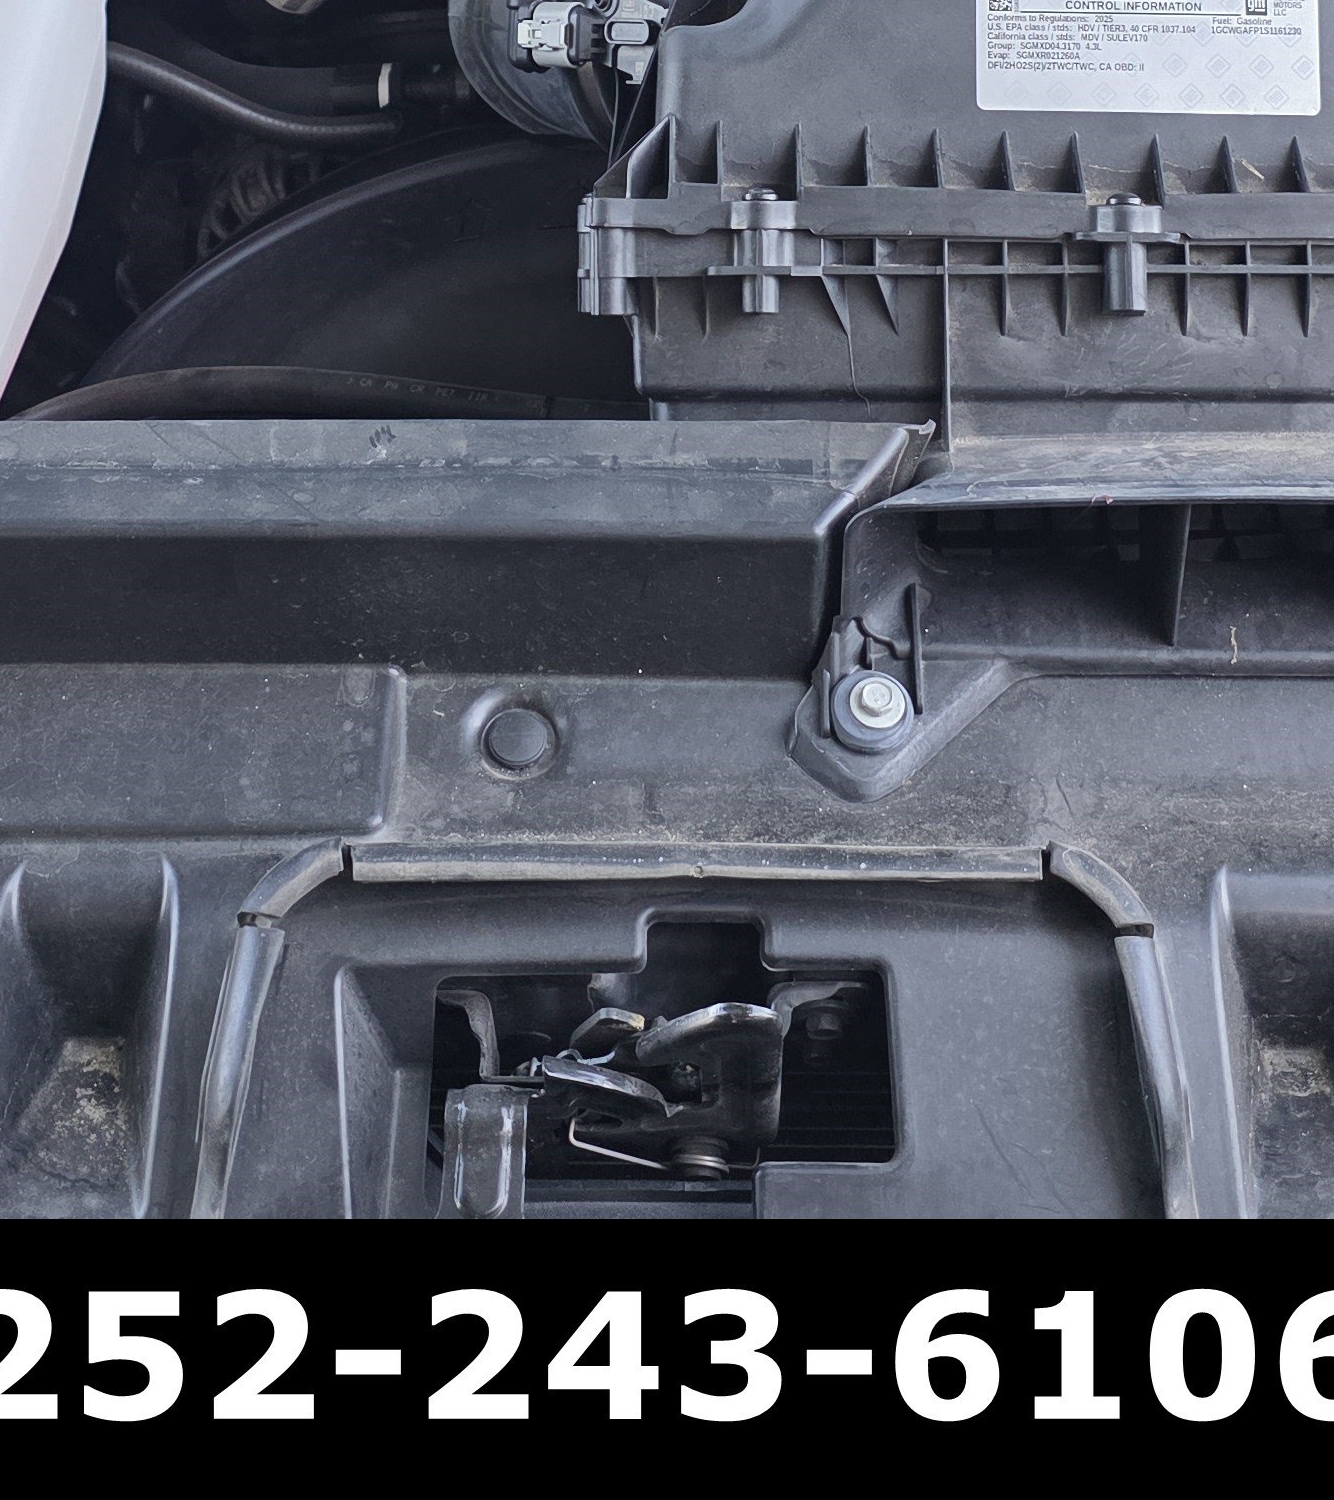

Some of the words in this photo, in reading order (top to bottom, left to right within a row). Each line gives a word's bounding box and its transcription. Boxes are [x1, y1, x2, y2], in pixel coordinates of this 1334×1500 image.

[1066, 1, 1118, 10] CONTROL
[1123, 2, 1202, 12] INFORMATION
[988, 14, 1027, 22] Conforms
[1039, 15, 1089, 24] Regulations:
[1095, 15, 1113, 23] 2025
[1237, 17, 1272, 25] Gasoline
[1078, 24, 1095, 32] HDV
[988, 32, 1025, 40] California
[1028, 33, 1048, 41] class
[1056, 33, 1075, 41] stds:
[1106, 34, 1148, 42] SULEV170
[988, 42, 1015, 51] Group:
[1085, 43, 1102, 51] 4.3L
[988, 51, 1010, 60] Evap:
[1115, 63, 1136, 71] OBD:
